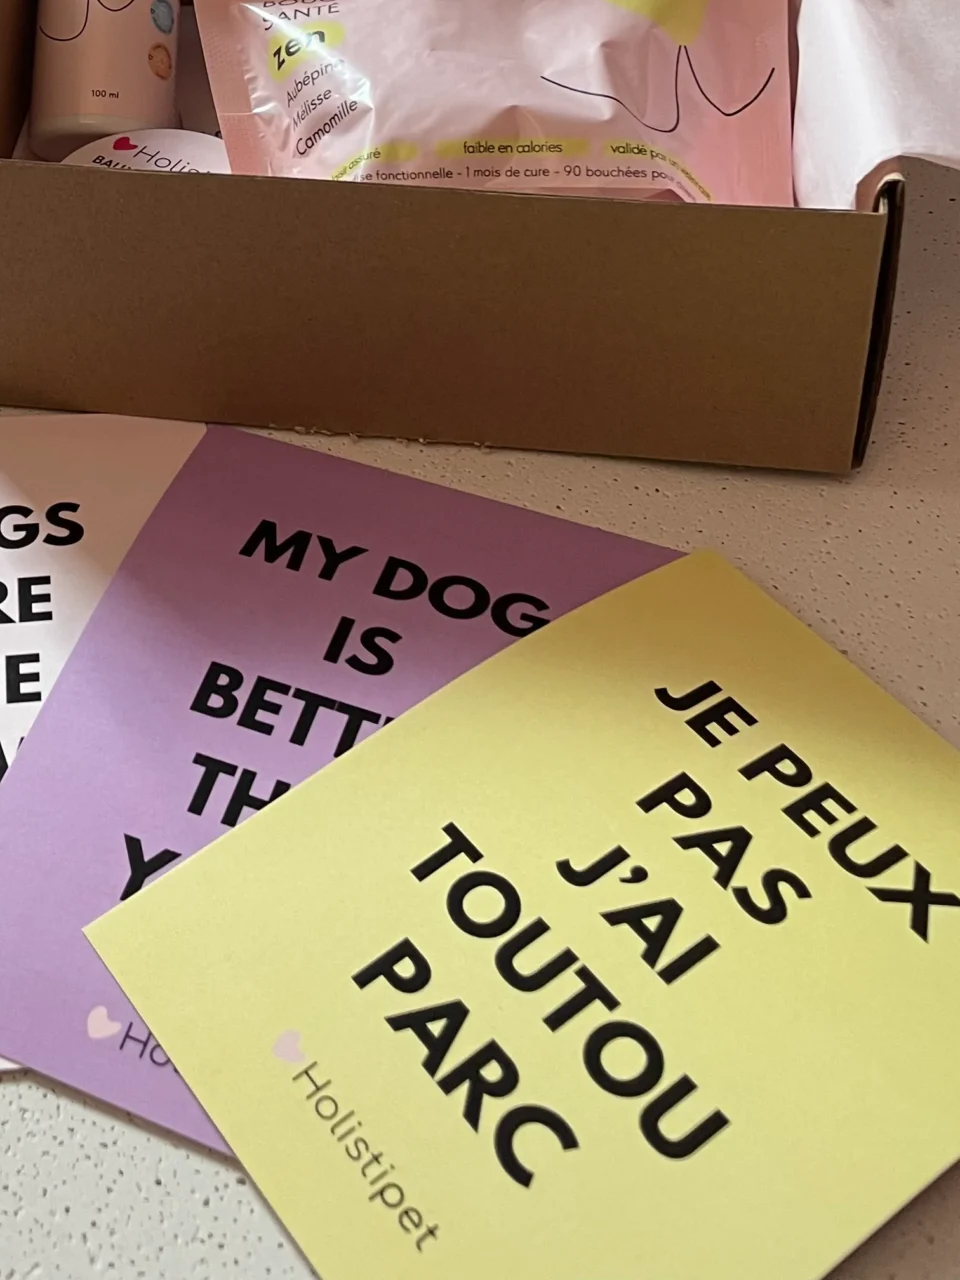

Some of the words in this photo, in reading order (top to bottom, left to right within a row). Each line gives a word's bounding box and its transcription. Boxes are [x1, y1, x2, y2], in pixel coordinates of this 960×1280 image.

[262, 3, 340, 30] SANTÉ
[273, 30, 326, 71] zen
[91, 89, 107, 98] 100
[108, 91, 120, 99] ml
[292, 88, 332, 132] Mélisse
[296, 100, 358, 156] Camomille
[463, 141, 495, 154] faible
[497, 144, 513, 153] en
[516, 140, 563, 153] calories
[610, 143, 648, 155] validé
[133, 145, 211, 173] Holi
[376, 167, 454, 181] fonctionnelle
[473, 167, 501, 177] mois
[505, 166, 520, 177] de
[523, 168, 550, 177] cure
[563, 165, 581, 177] 90
[586, 166, 647, 178] bouchées
[239, 519, 369, 581] MY
[372, 556, 552, 638] DOG
[323, 616, 403, 676] IS
[189, 661, 397, 759] BETT
[654, 680, 759, 748] JE
[737, 743, 960, 944] PEUX
[635, 771, 813, 926] PAS
[555, 844, 722, 986] J'AI
[409, 821, 731, 1161] TOUTOU
[351, 936, 581, 1189] PARC
[292, 1060, 440, 1254] Holistipet
